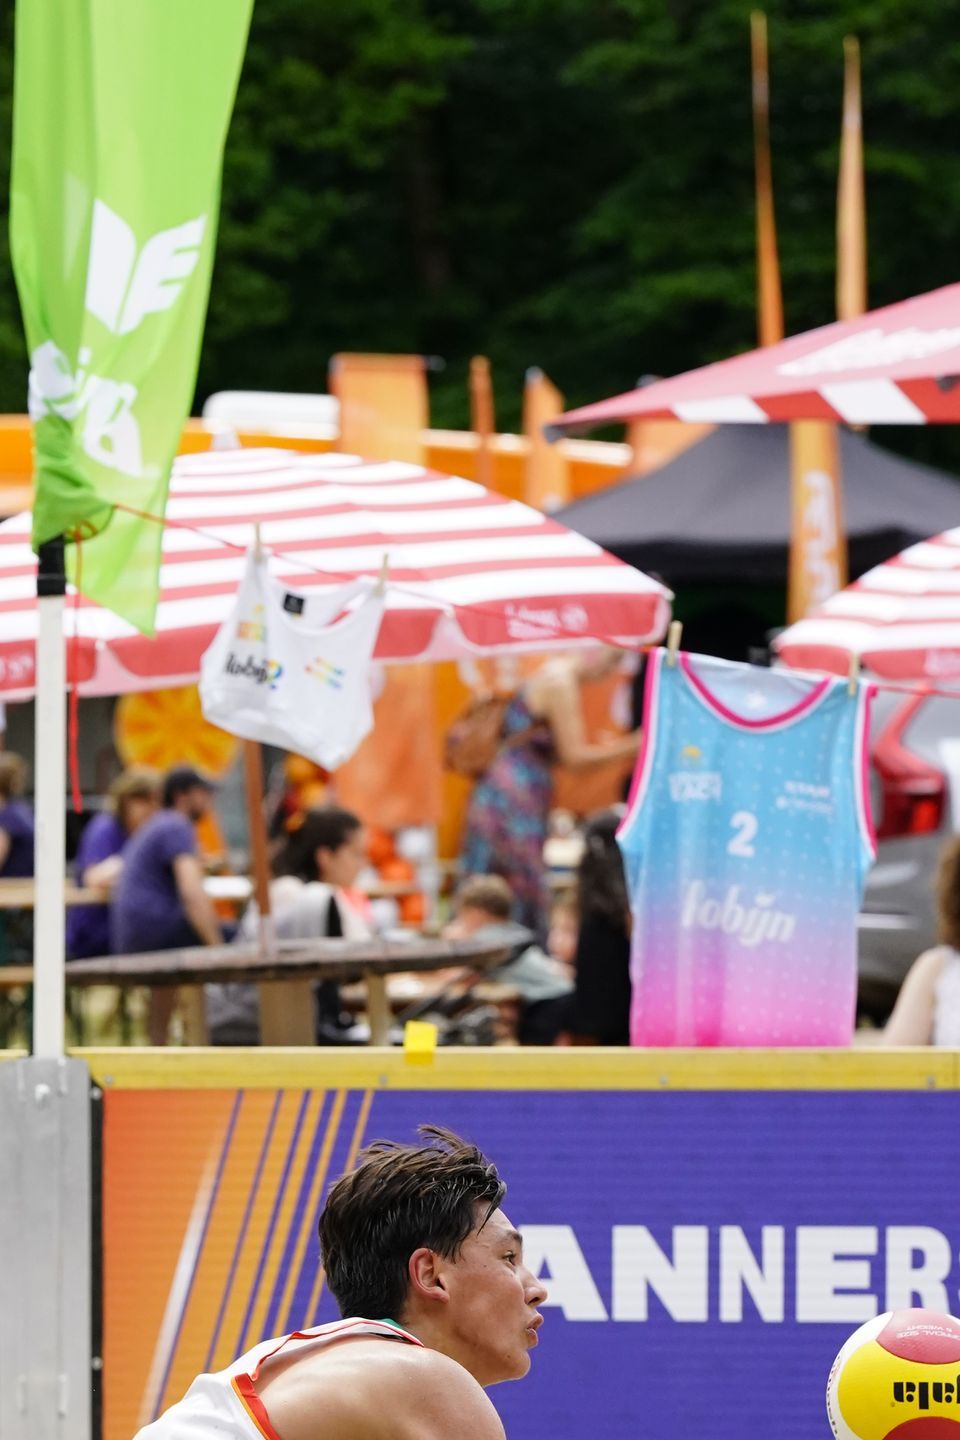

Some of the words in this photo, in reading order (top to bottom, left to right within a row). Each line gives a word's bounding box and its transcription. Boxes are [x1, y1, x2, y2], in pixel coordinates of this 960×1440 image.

[726, 811, 759, 858] 2
[516, 1224, 960, 1324] ANNER
[893, 1375, 960, 1409] ala
